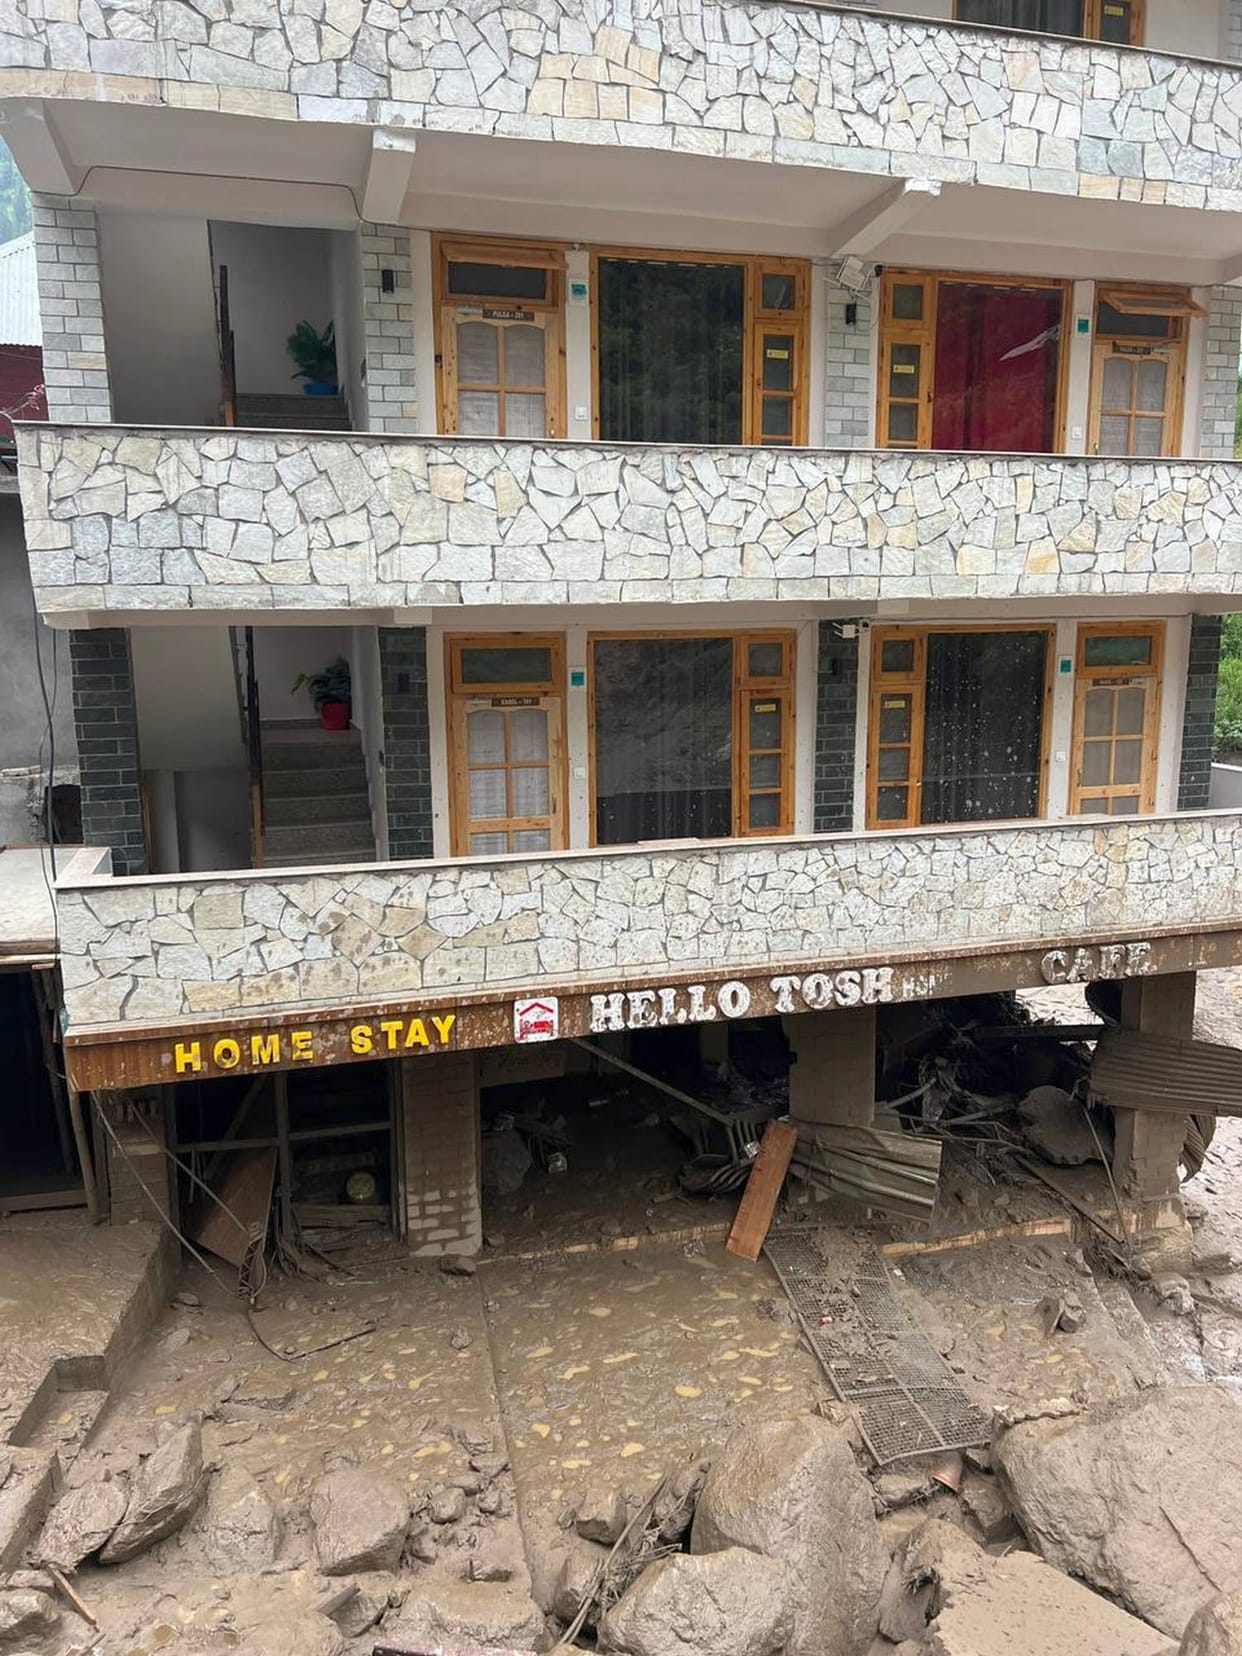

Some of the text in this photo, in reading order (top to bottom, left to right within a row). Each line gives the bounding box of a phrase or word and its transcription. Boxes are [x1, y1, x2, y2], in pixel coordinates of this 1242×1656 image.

[174, 1031, 314, 1074] HOME
[350, 1014, 456, 1055] STAY
[590, 981, 751, 1033] HELLO
[769, 967, 895, 1014] TOSH
